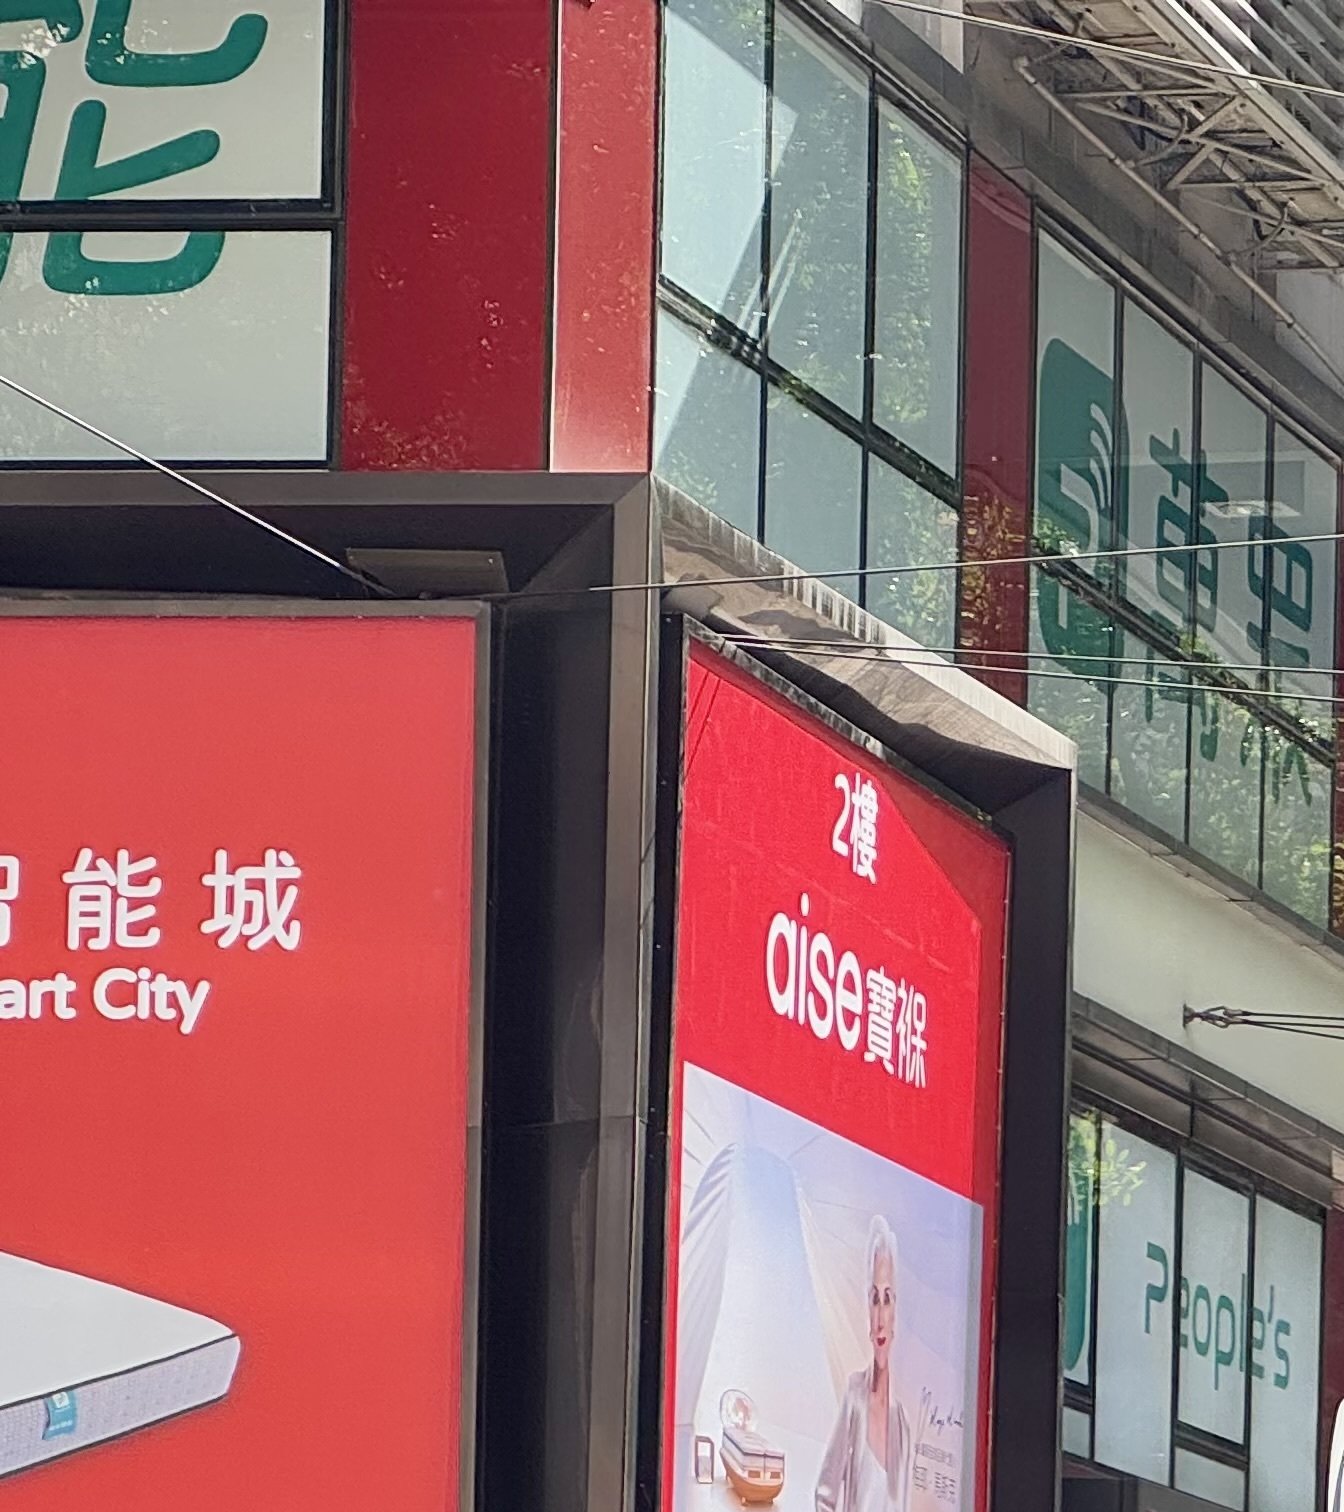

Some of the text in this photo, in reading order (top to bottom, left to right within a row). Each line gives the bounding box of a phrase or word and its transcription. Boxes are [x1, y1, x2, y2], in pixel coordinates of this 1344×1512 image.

[832, 772, 879, 884] 2樓
[0, 848, 301, 951] 能城
[0, 967, 211, 1035] art City
[766, 892, 863, 1051] aise
[1144, 1241, 1291, 1391] People's
